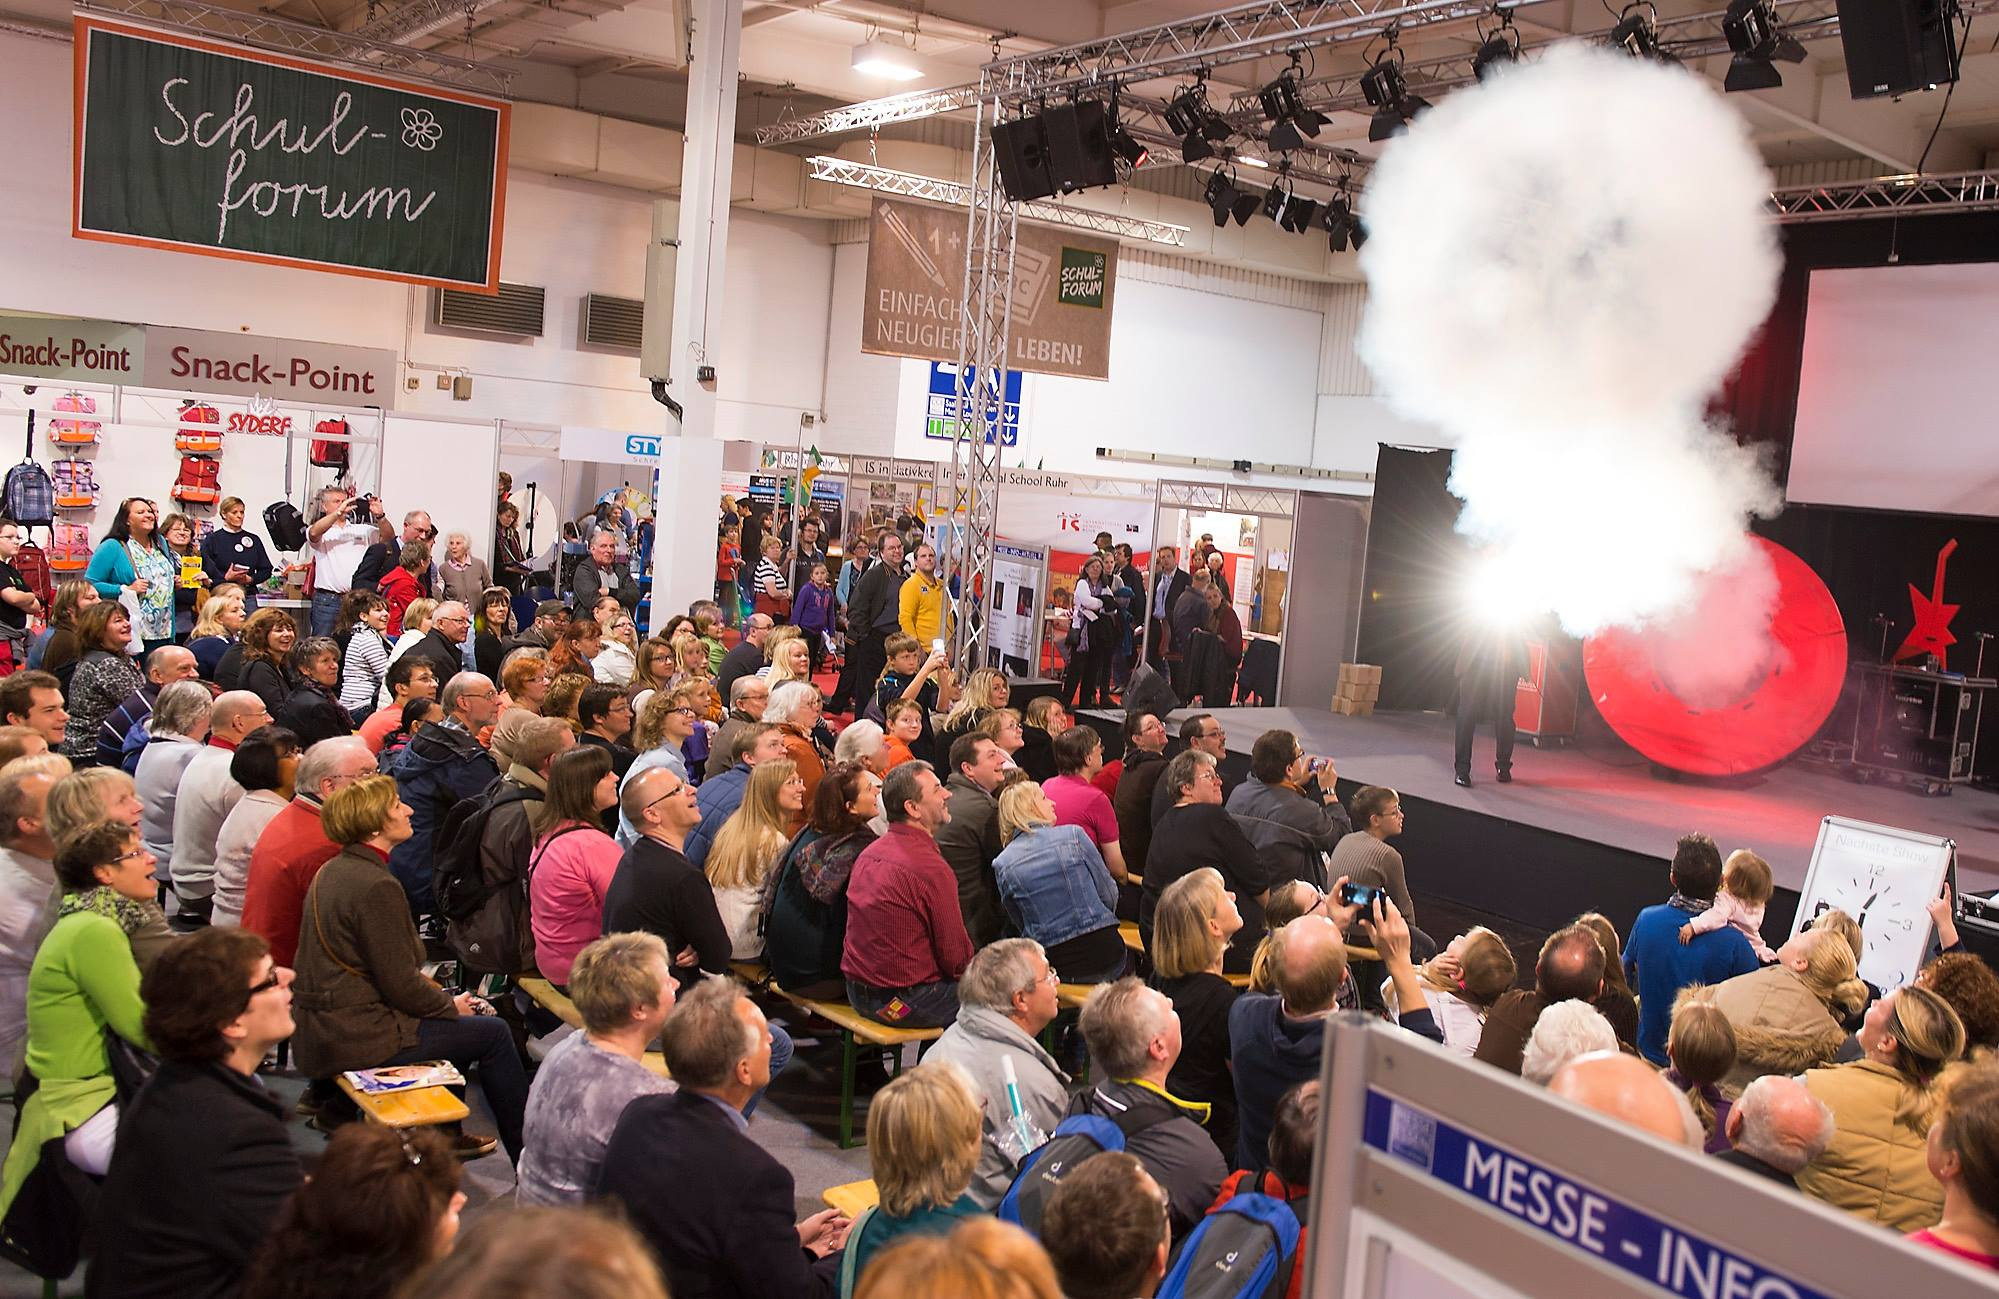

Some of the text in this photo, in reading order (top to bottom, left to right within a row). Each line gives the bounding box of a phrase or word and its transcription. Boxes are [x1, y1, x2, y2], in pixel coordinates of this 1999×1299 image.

[154, 77, 387, 156] Schul-
[217, 148, 437, 245] forum
[1061, 265, 1103, 282] SCHUL-
[1062, 281, 1103, 299] FORUM
[879, 288, 964, 322] EINFACH
[0, 333, 131, 373] Snack-Point
[1016, 336, 1084, 367] LEBEN!
[170, 346, 375, 395] Snack-Point
[1009, 472, 1043, 487] School
[1045, 475, 1069, 488] Ruhr
[1463, 1139, 1609, 1255] MESSE
